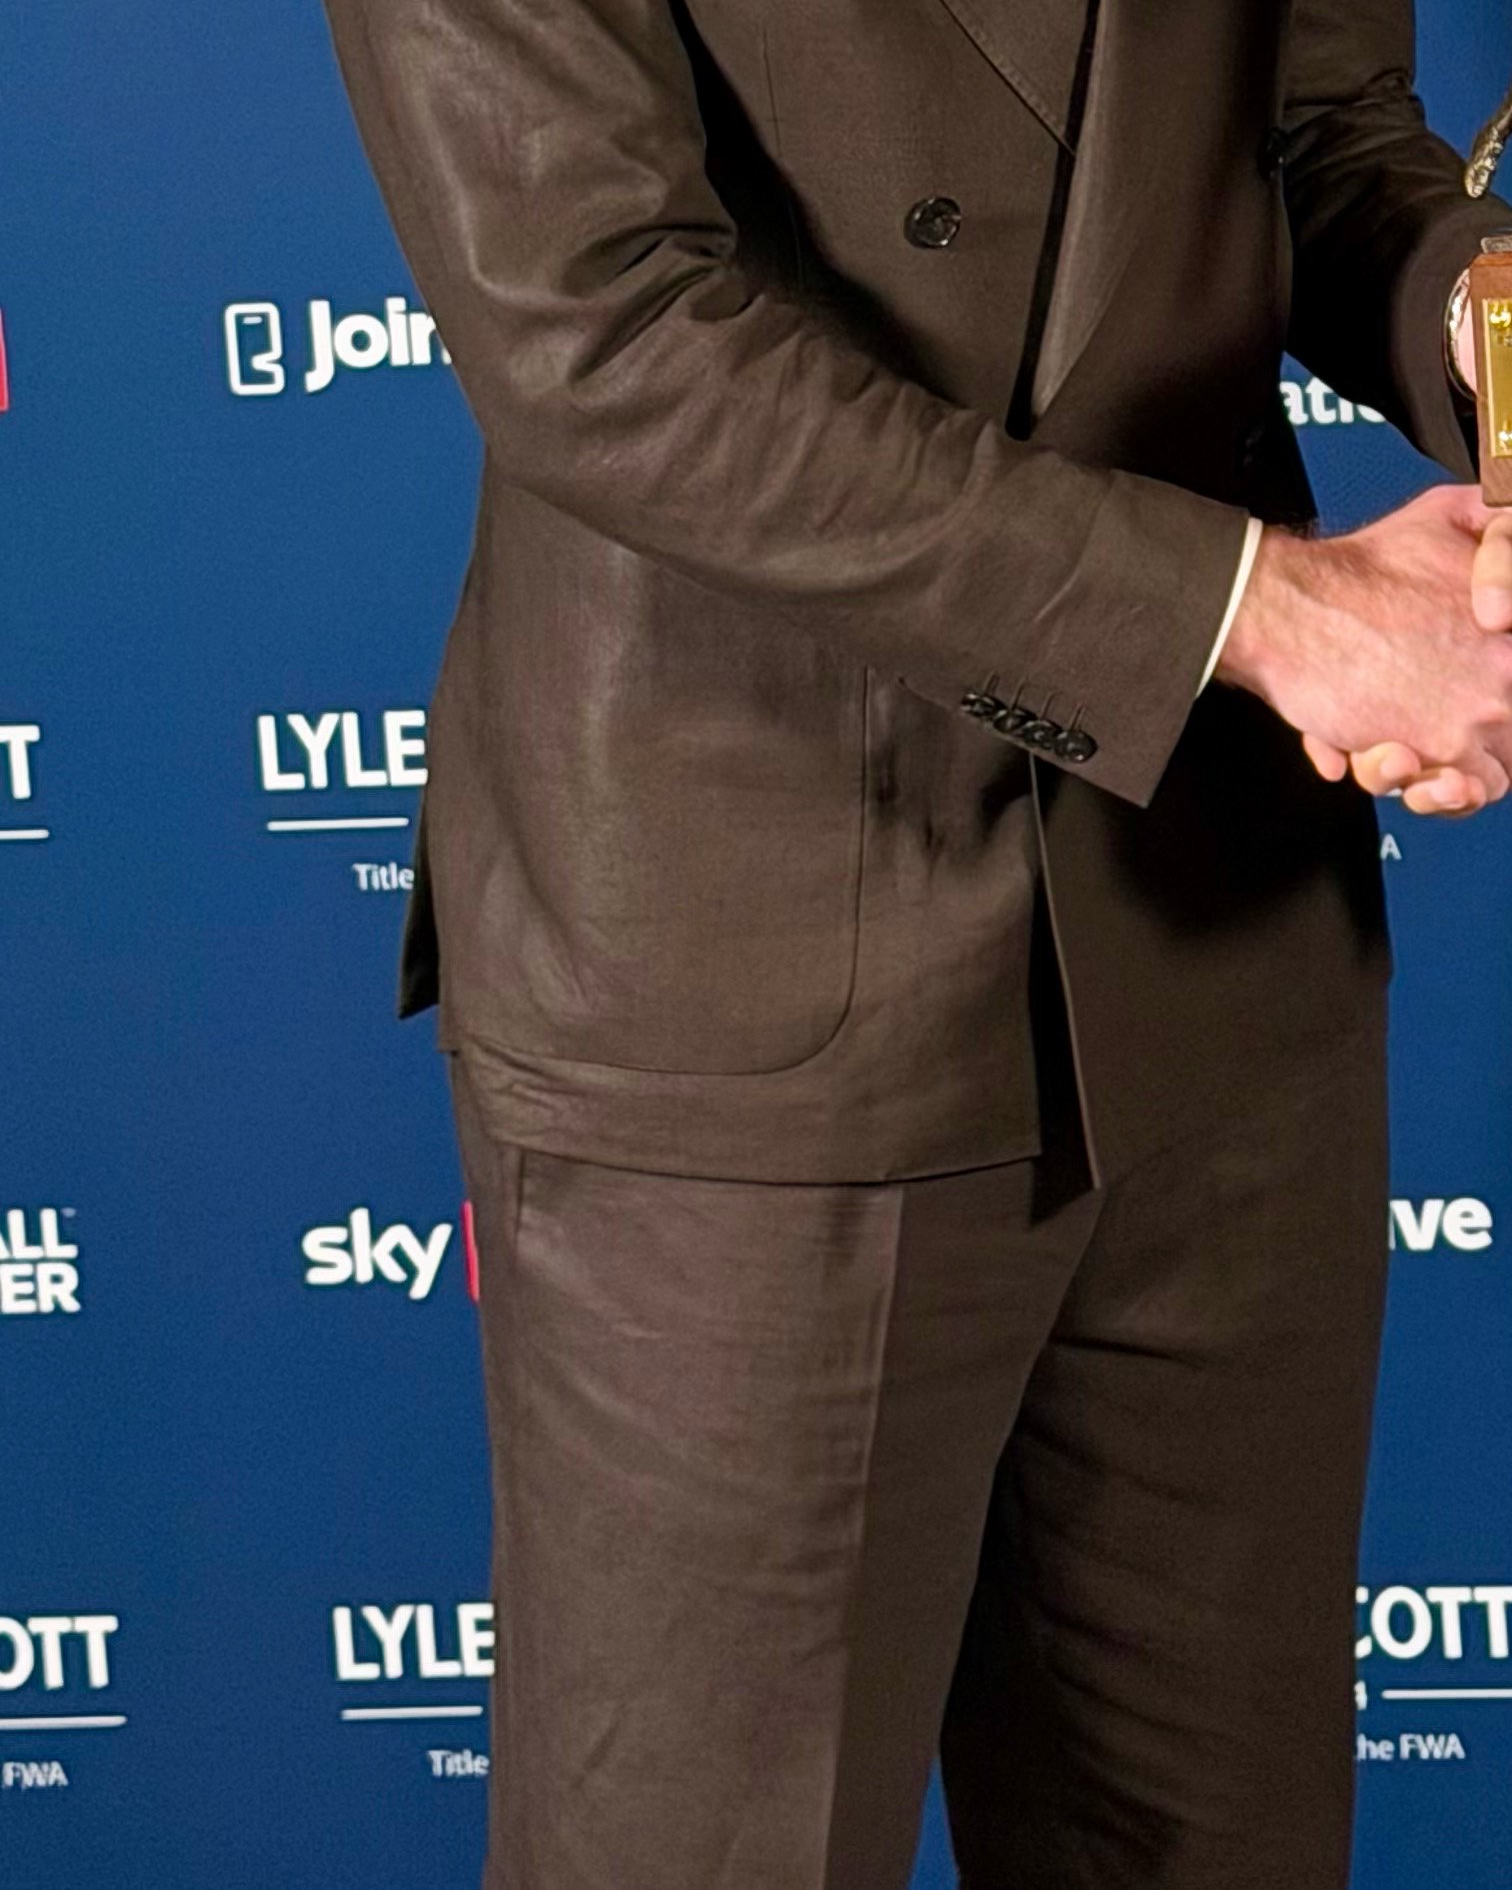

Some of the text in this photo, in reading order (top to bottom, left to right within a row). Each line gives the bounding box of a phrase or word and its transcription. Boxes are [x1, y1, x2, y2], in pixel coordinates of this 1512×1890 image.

[258, 710, 429, 791] LYLE
[354, 862, 415, 890] Title
[1389, 1197, 1493, 1251] ve
[302, 1207, 452, 1300] sky
[333, 1603, 496, 1680] LYLE
[429, 1750, 489, 1775] Title
[1400, 1734, 1464, 1759] FWA
[3, 1762, 67, 1786] FWA
